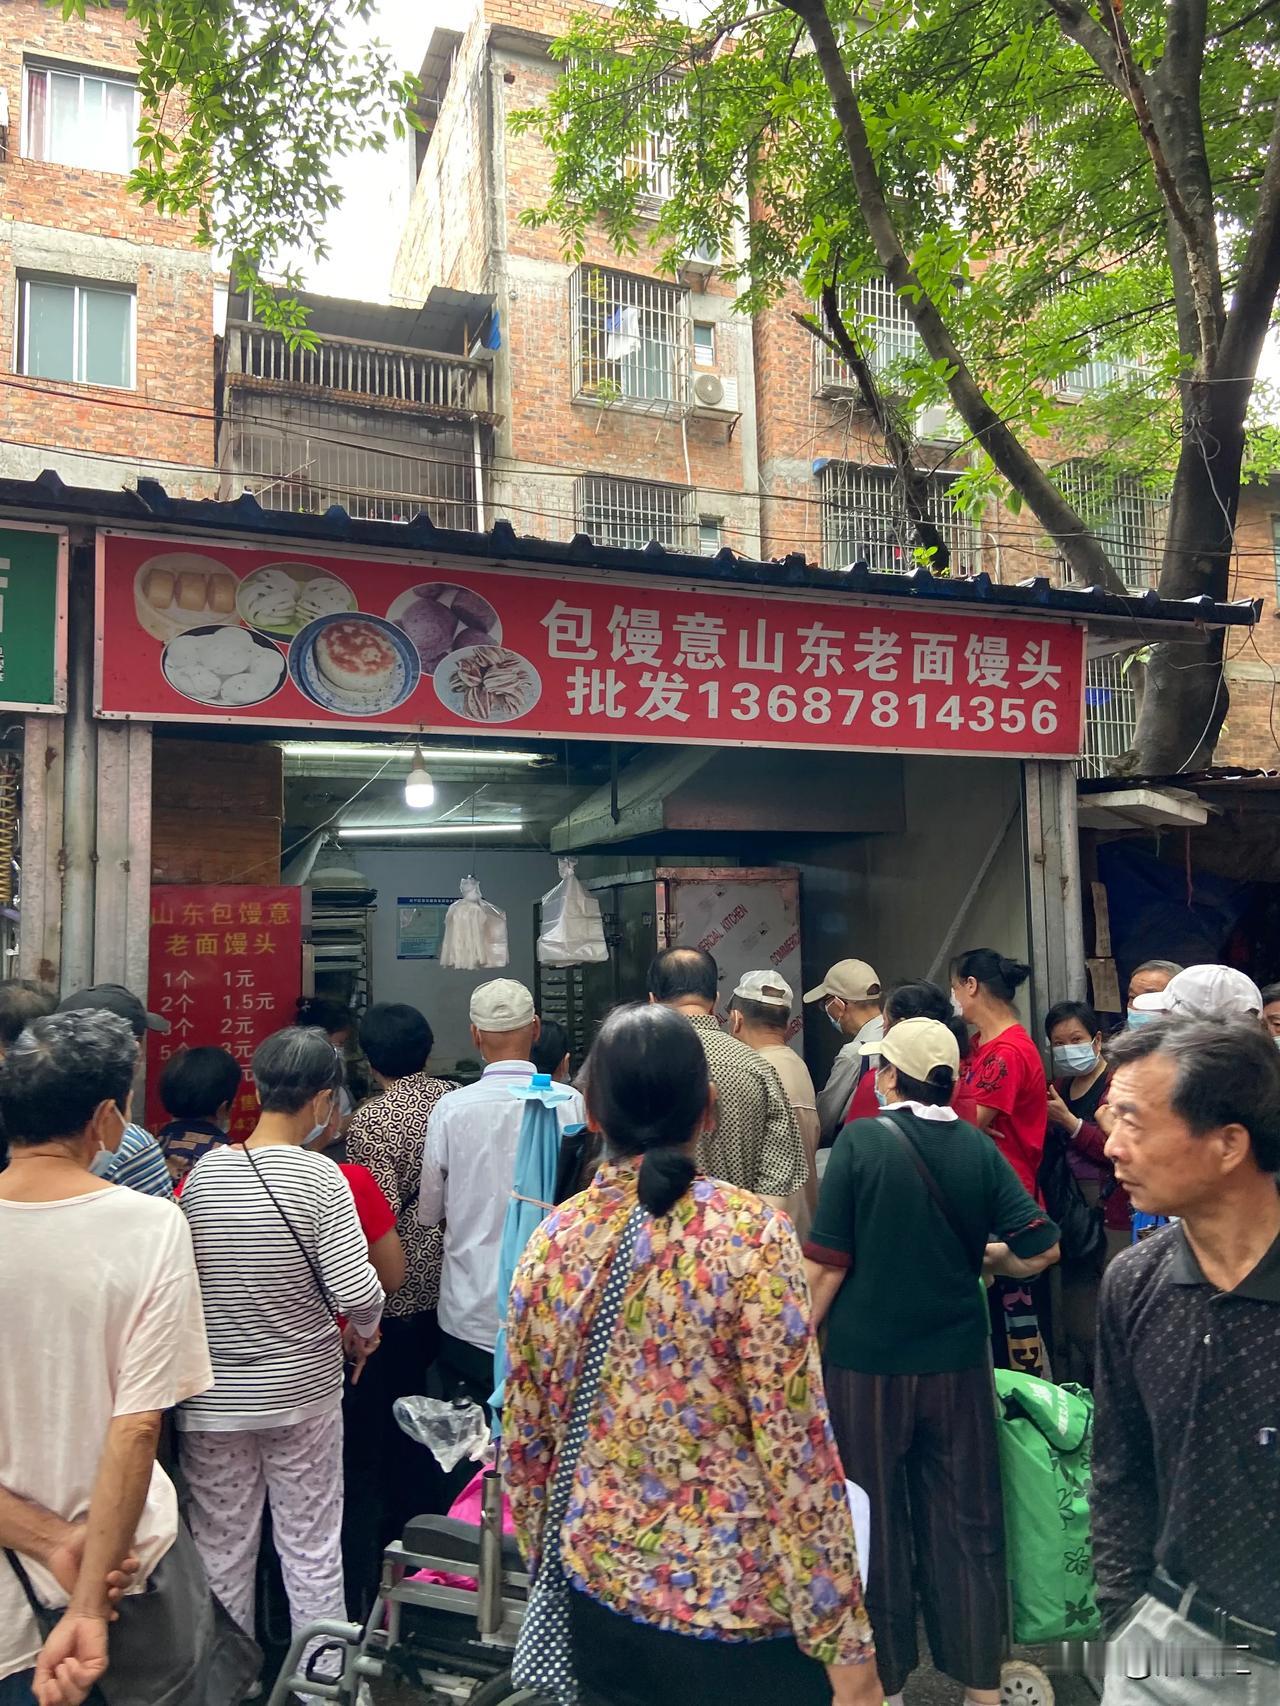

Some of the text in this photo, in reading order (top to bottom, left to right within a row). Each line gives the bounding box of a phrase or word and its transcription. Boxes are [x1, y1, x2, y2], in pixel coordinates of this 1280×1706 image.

[540, 600, 1062, 691] 包馒意山东老面馒头
[151, 902, 291, 926] 山东包馒意
[720, 903, 749, 932] KITCHEN
[166, 932, 277, 956] 老面馒头
[162, 970, 255, 989] 1个 1元
[160, 993, 275, 1014] 2个 1.5元
[220, 1017, 254, 1035] 2元
